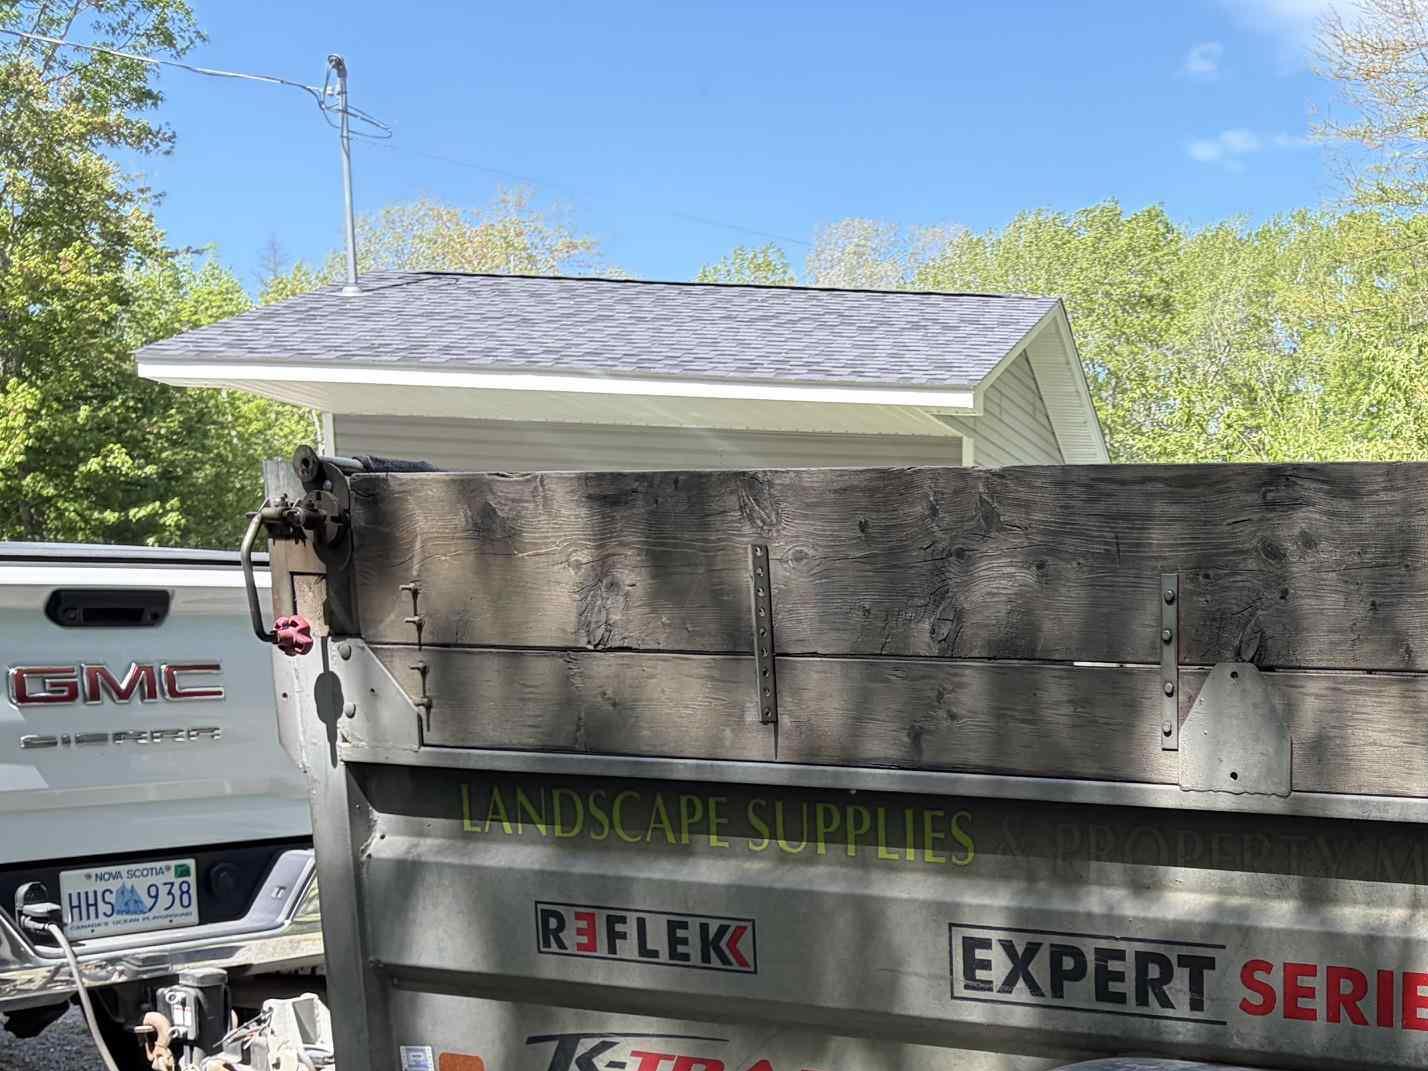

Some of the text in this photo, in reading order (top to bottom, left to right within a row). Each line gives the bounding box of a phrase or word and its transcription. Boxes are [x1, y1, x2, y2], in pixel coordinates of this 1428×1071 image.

[8, 663, 224, 706] GMC
[20, 727, 222, 749] SIERRA
[461, 784, 729, 848] LANDSCAPE
[747, 800, 976, 866] SUPPLIES
[1054, 822, 1350, 892] PROPERTY
[95, 872, 123, 882] NOVA
[126, 866, 165, 880] SCOTIA
[68, 880, 192, 922] HHS 938
[961, 936, 1216, 1013] EXPERT
